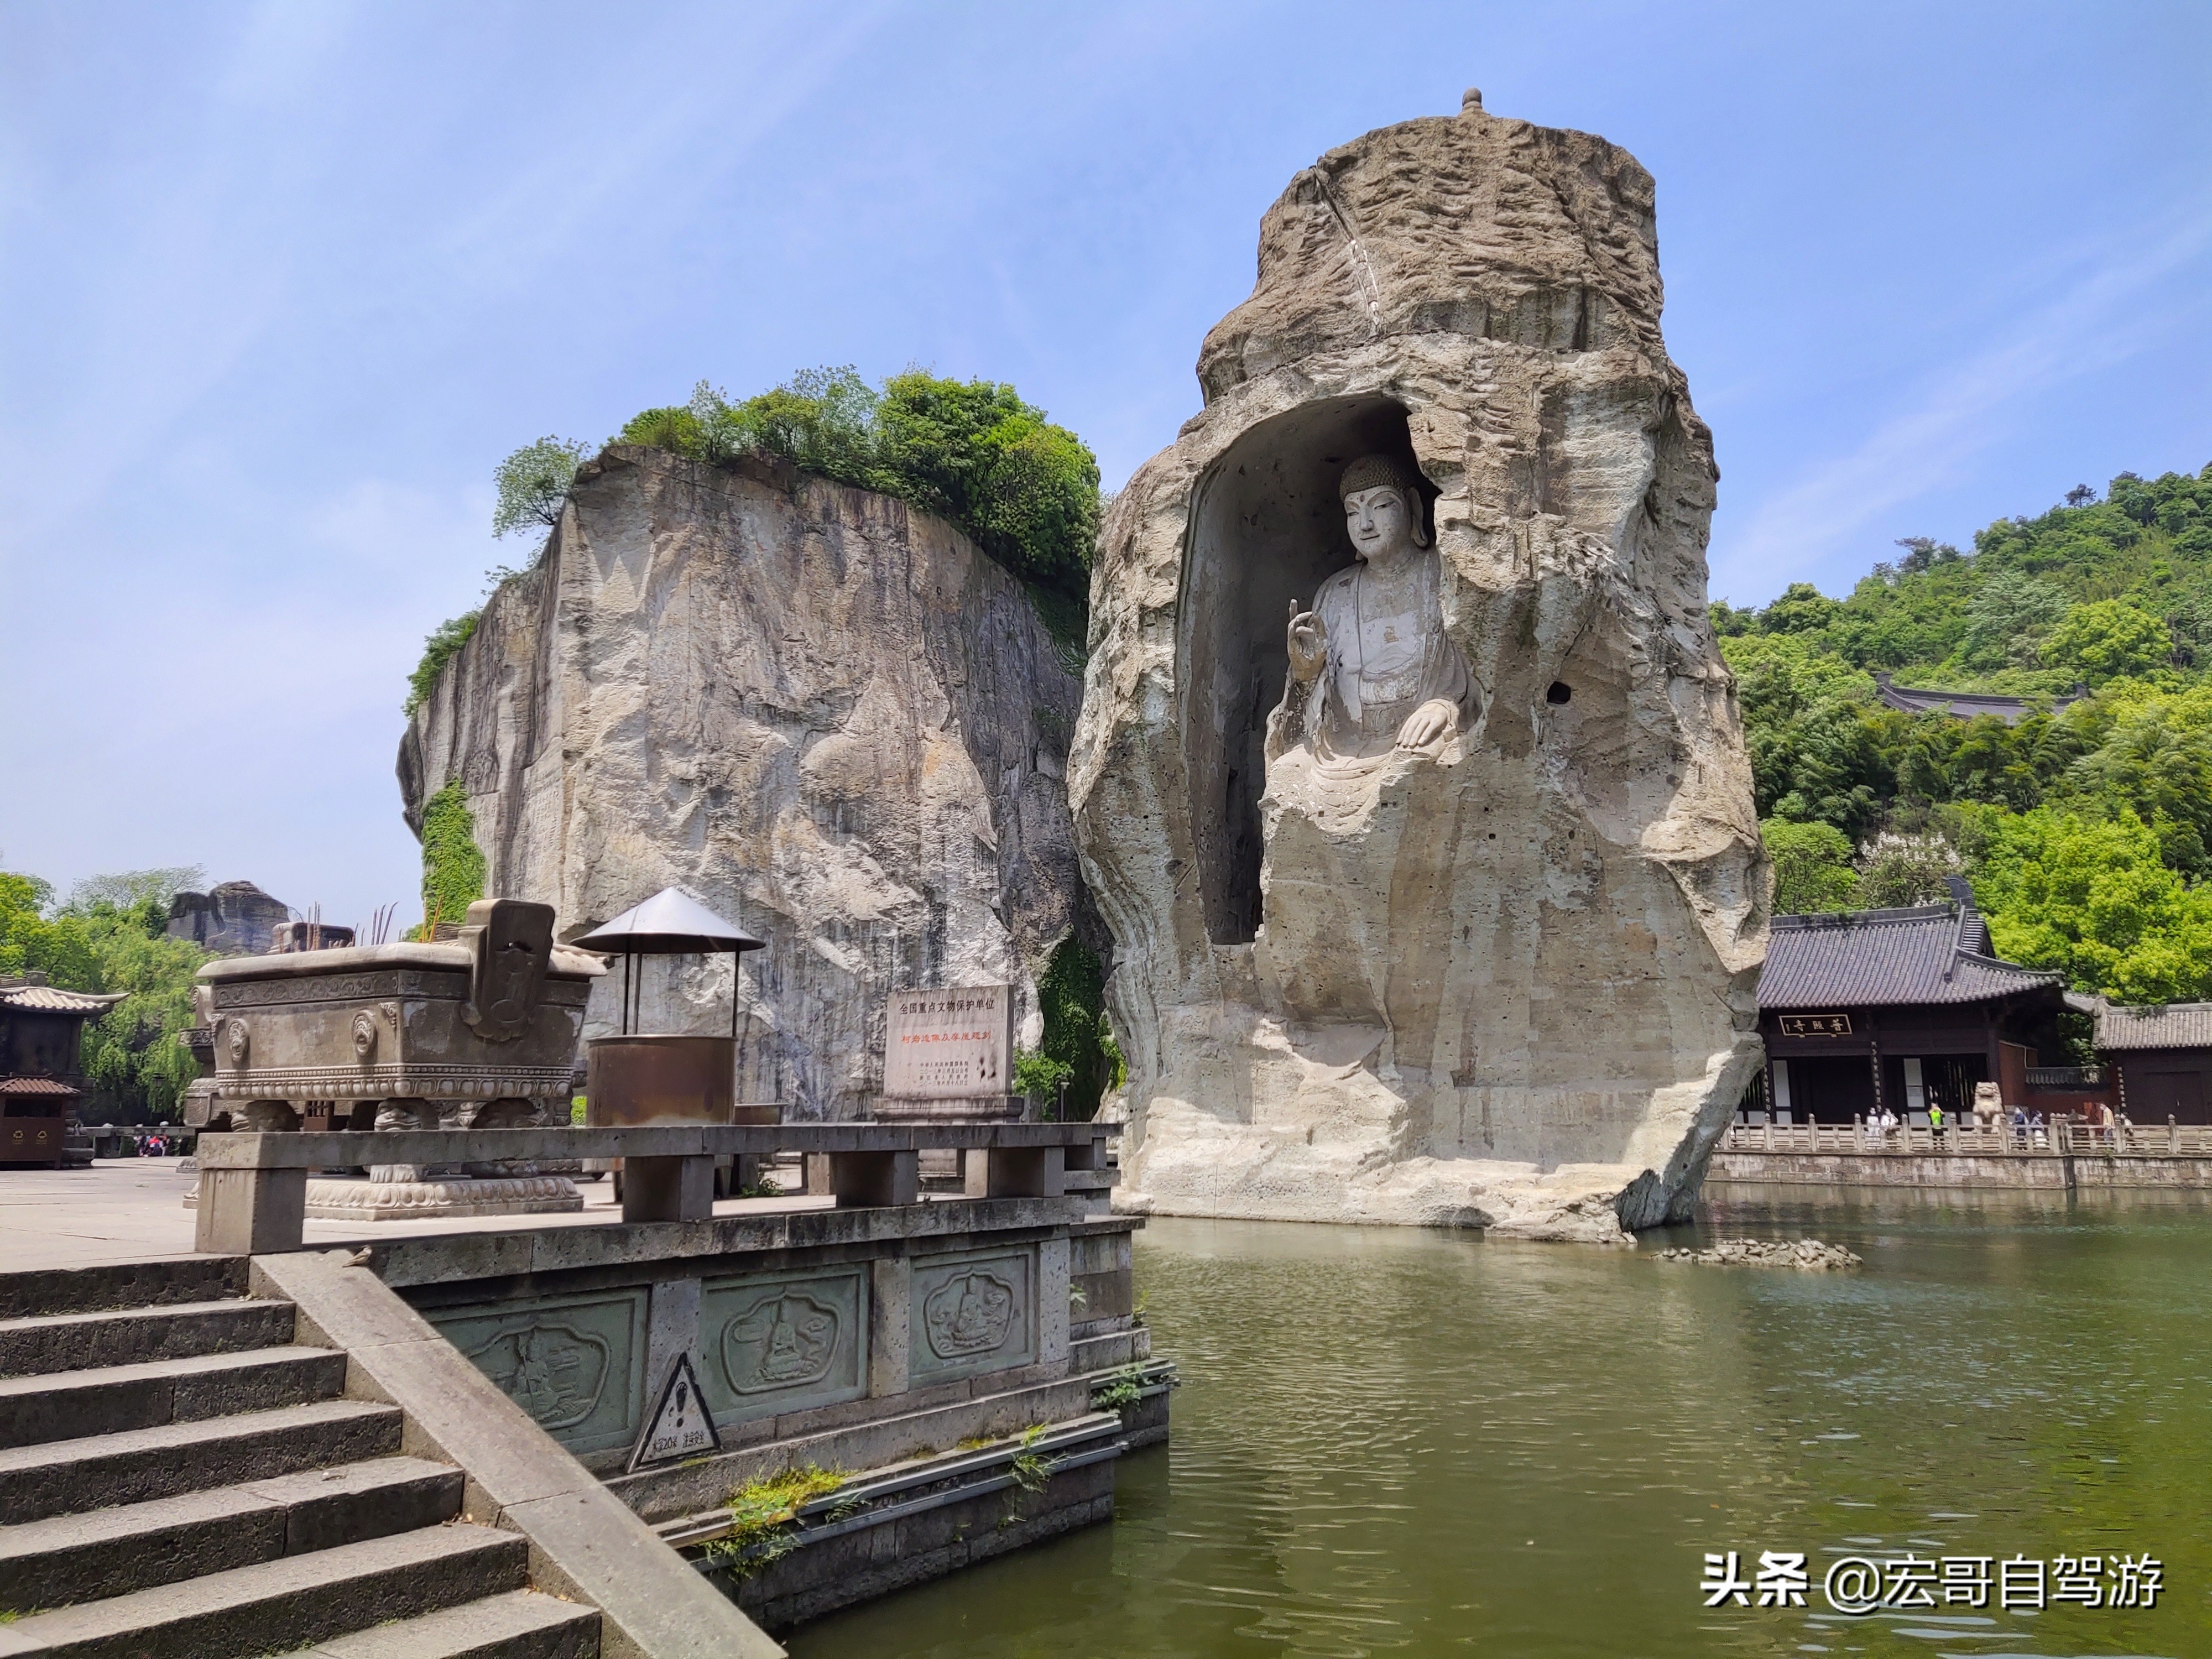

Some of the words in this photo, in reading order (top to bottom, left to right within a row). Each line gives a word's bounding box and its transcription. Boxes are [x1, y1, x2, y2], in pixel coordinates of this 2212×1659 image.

[899, 998, 994, 1015] 全国重点文物保护单位
[1793, 1018, 1844, 1032] 普照寺
[901, 1030, 991, 1043] 柯岩造像及摩崖题刻
